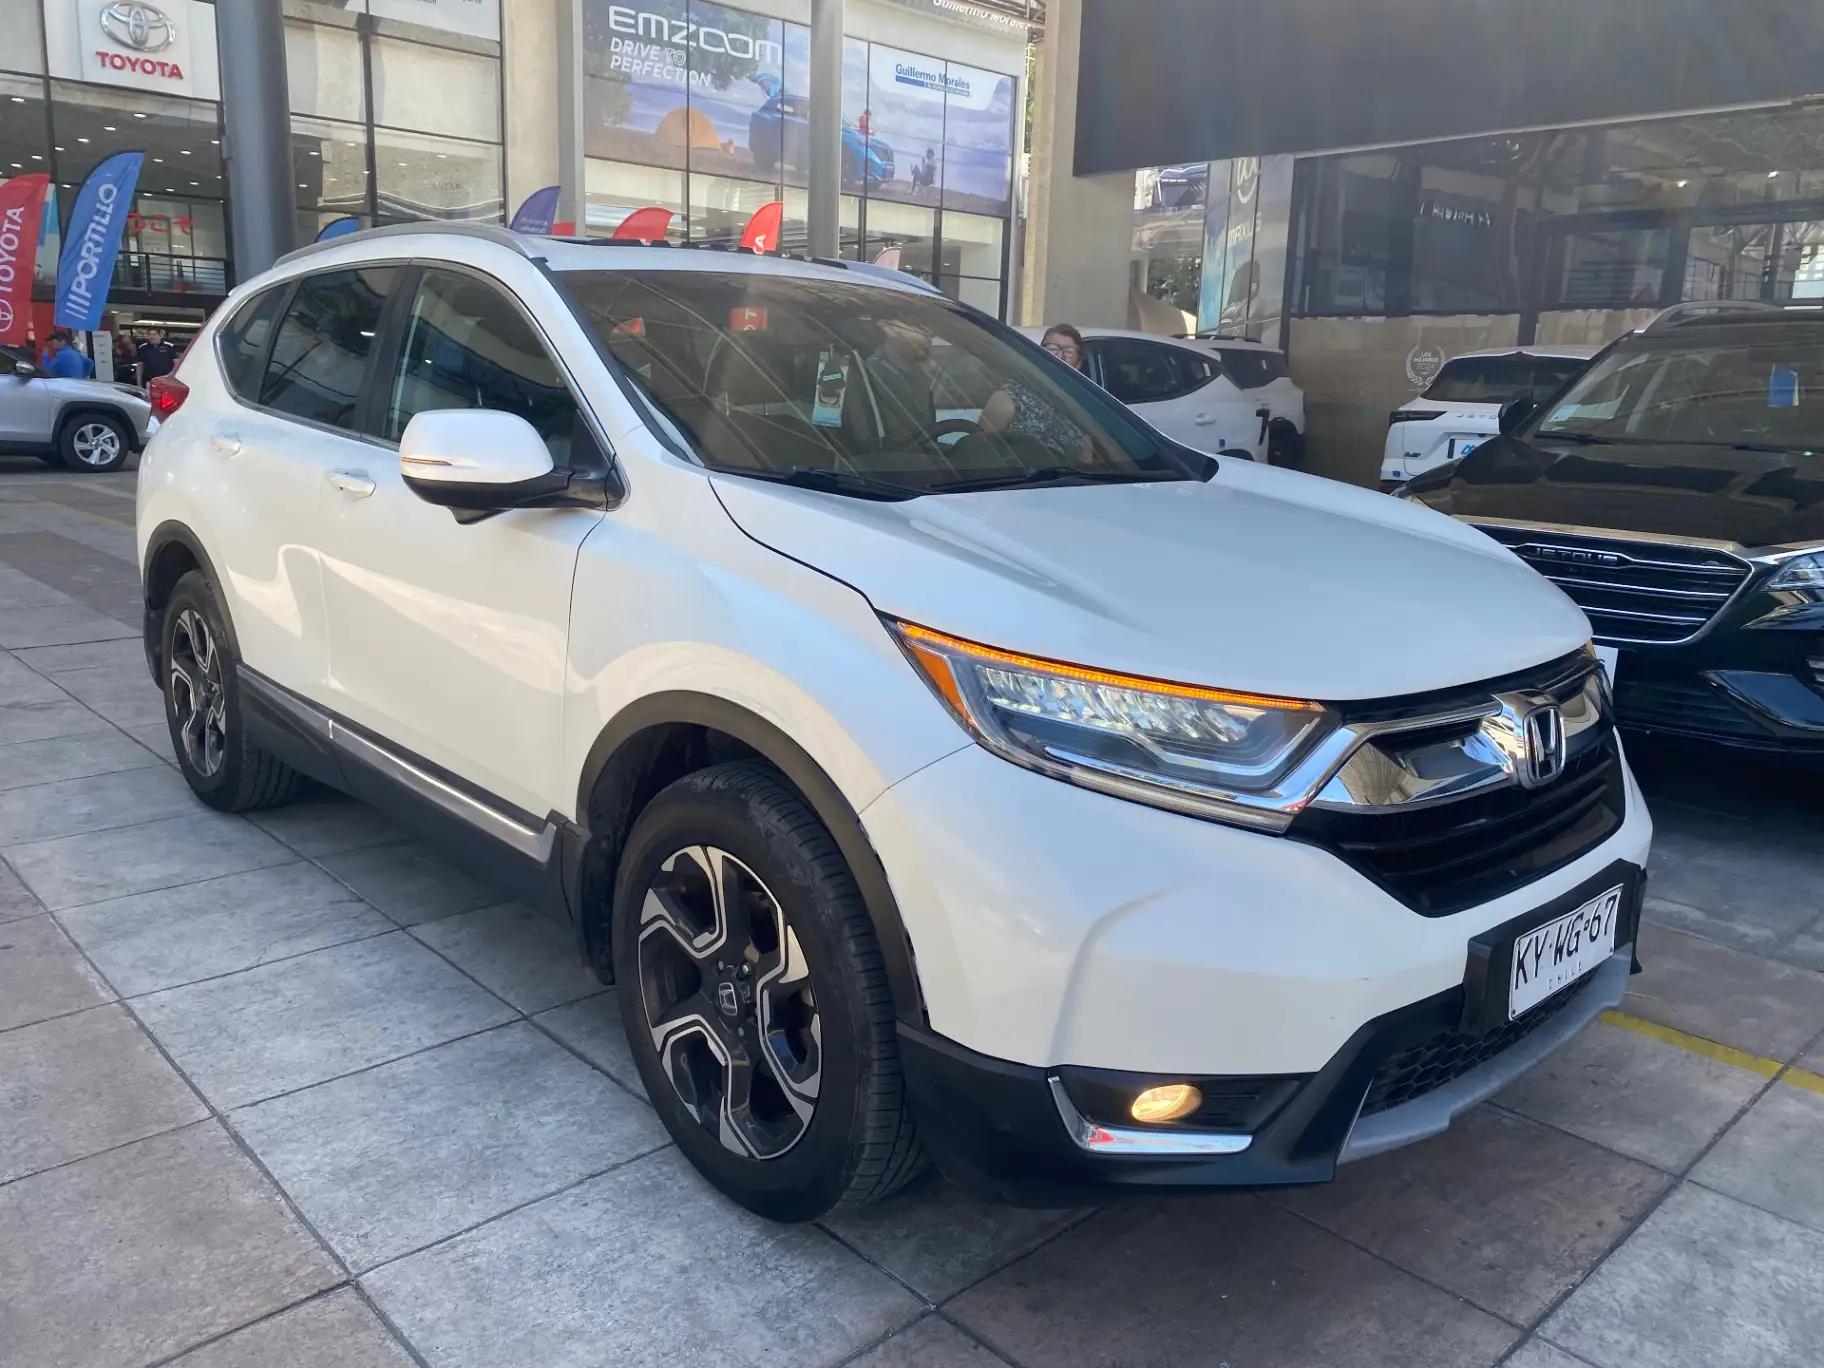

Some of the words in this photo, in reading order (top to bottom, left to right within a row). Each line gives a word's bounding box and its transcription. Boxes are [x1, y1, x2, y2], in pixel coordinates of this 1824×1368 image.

[95, 51, 184, 79] TOYOTA
[610, 37, 660, 60] DRIVE
[664, 47, 687, 66] TO
[610, 56, 712, 87] PERFECTION
[895, 63, 937, 82] Guillermo
[938, 73, 970, 89] Morales
[70, 183, 118, 298] PORTILLO
[1536, 547, 1618, 565] JETOUR
